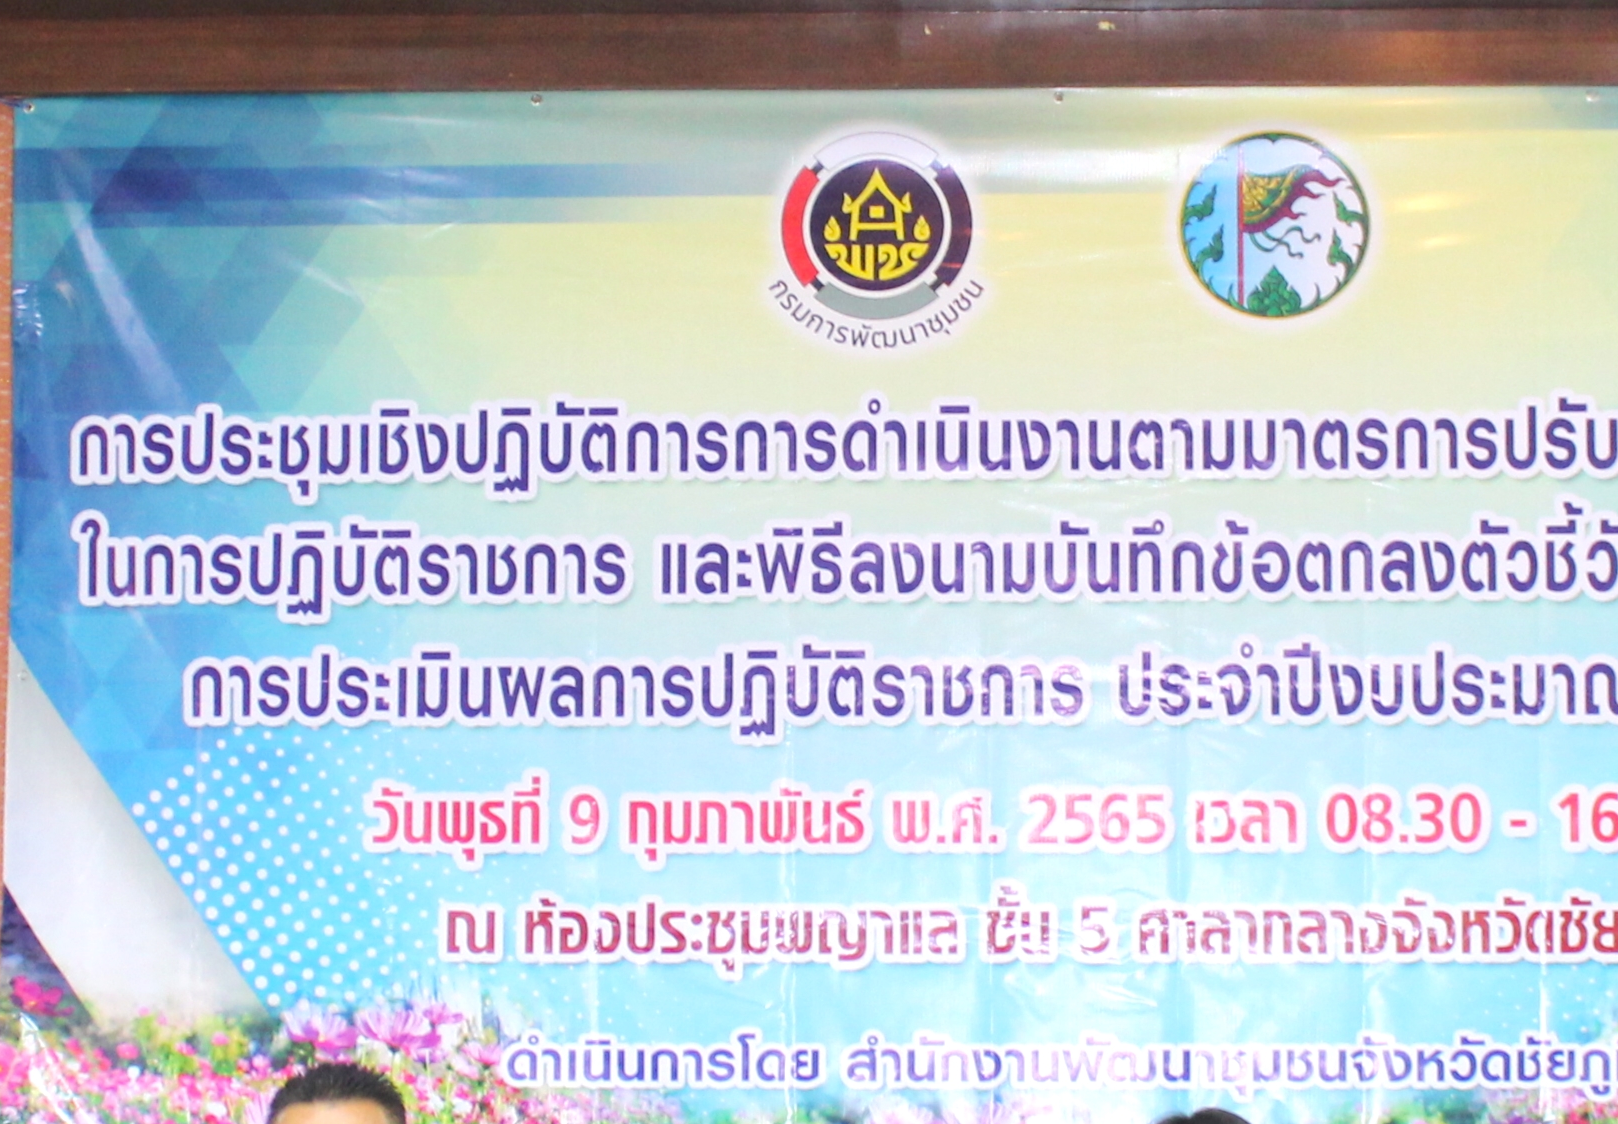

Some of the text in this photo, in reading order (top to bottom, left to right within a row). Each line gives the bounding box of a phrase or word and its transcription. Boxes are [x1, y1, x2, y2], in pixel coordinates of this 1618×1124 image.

[768, 279, 984, 349] กรมการพัฒนาชุมชน
[79, 518, 626, 615] ในการปฏิบัติราชการ
[191, 644, 1084, 736] การประเมินผลการปฏิบัติราชการ
[372, 776, 542, 862] วันพุธที่
[569, 792, 600, 844] 9
[627, 786, 866, 862] กุมภาพันธ์
[892, 795, 999, 845] พ.ศ.
[1027, 792, 1167, 845] 2565
[1193, 799, 1299, 844] เวลา
[1325, 791, 1482, 845] 08.30
[1508, 816, 1529, 827] -
[447, 909, 495, 954] ณ
[524, 898, 959, 972] ห้องประชุมพญาแล
[986, 885, 1051, 955] ชั้น
[1079, 906, 1111, 954] 5
[506, 1033, 819, 1083] ดำเนินการโดย
